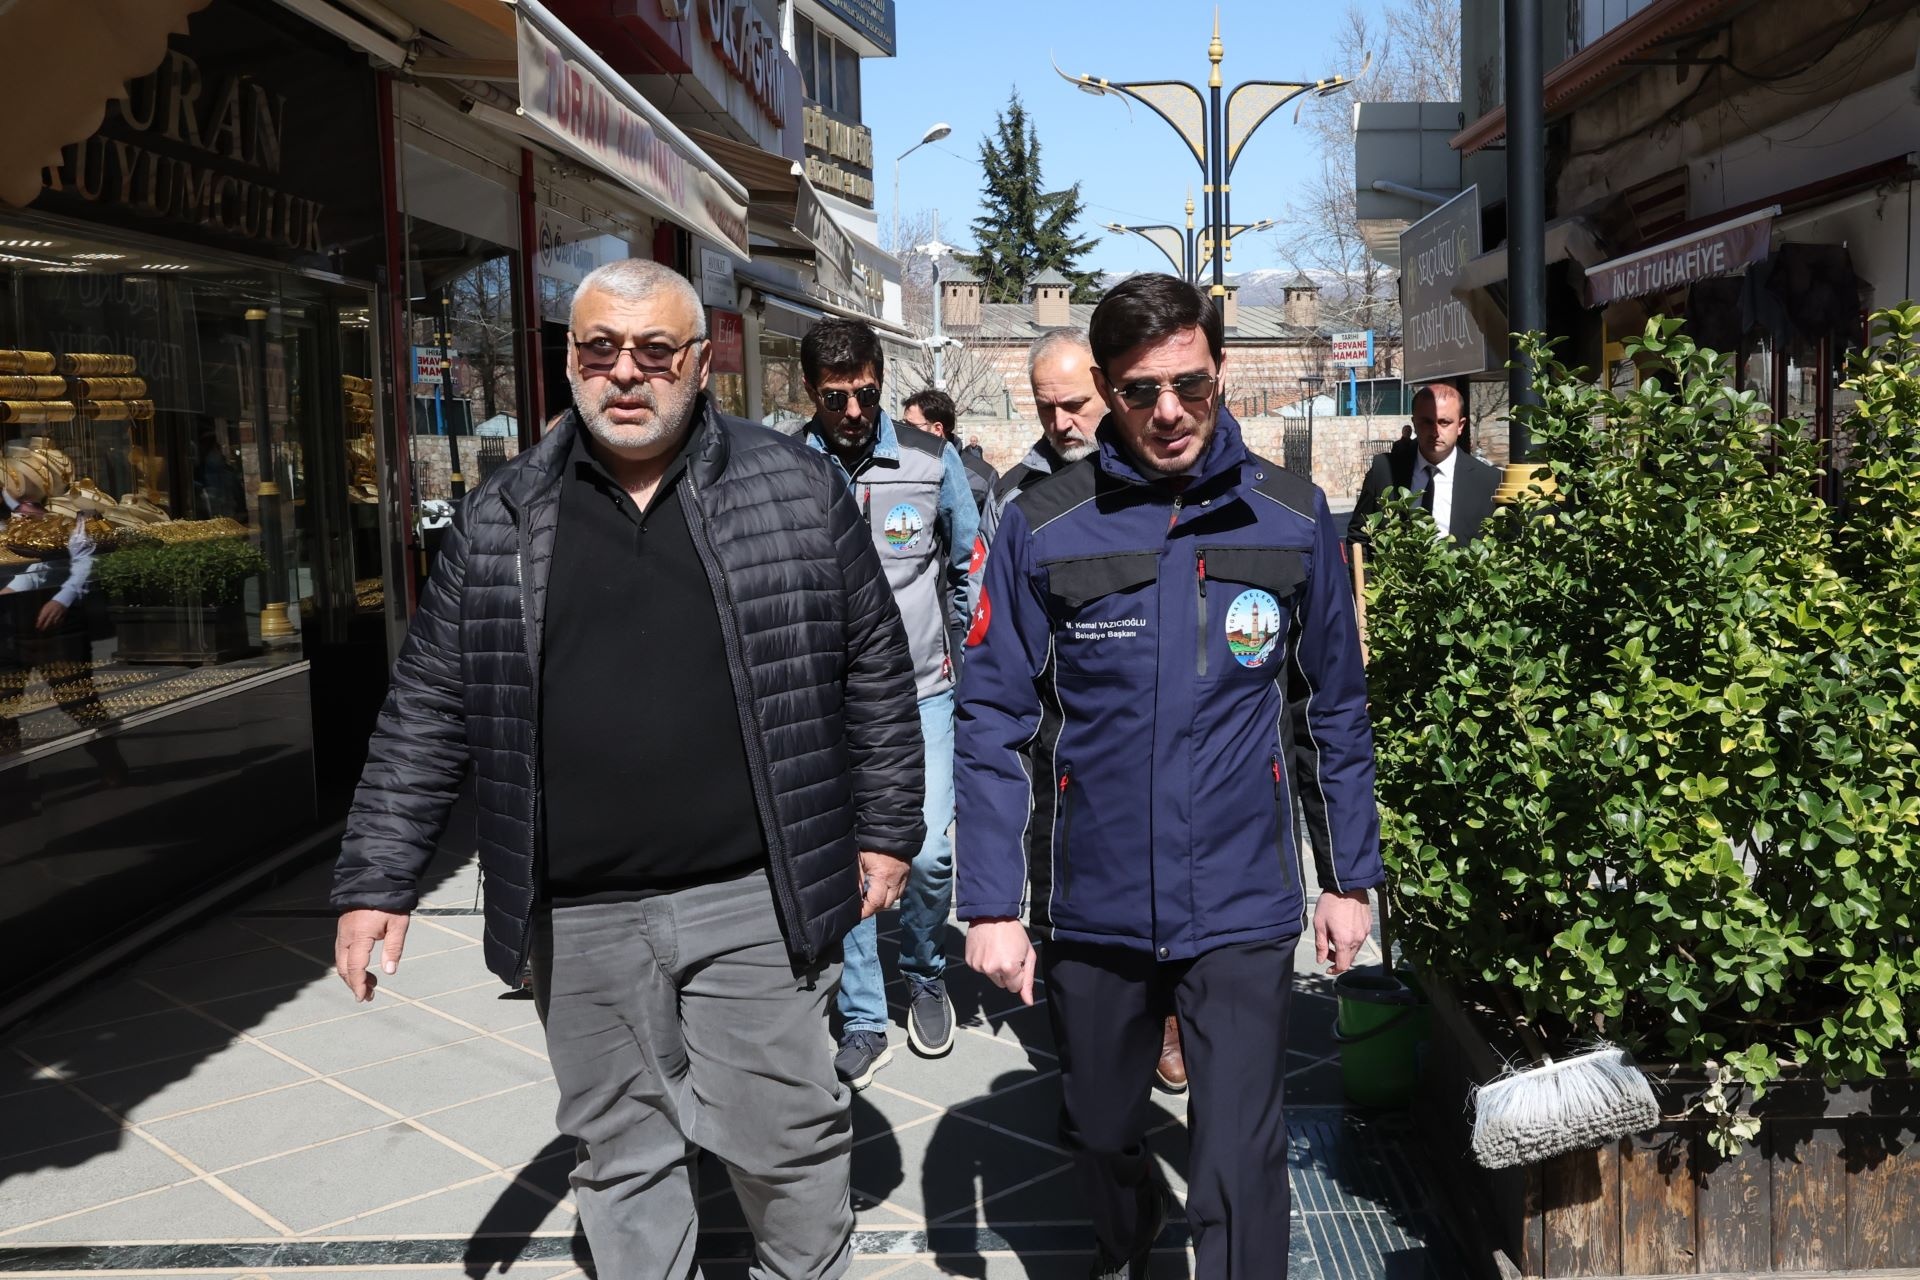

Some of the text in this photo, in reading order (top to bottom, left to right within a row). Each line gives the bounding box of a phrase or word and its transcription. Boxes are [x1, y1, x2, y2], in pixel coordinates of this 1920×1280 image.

[119, 48, 287, 174] URAN
[545, 47, 609, 154] TURAN
[1418, 229, 1456, 286] SELÇUKLU
[1613, 241, 1725, 298] İNCİ TUHAFİYE
[1333, 340, 1367, 350] PERVANE
[1333, 350, 1368, 360] HAMAMI
[1075, 621, 1097, 629] Kemal
[1098, 617, 1147, 629] YAZICIOĞLU
[1075, 630, 1137, 641] Belediye Başkanı
